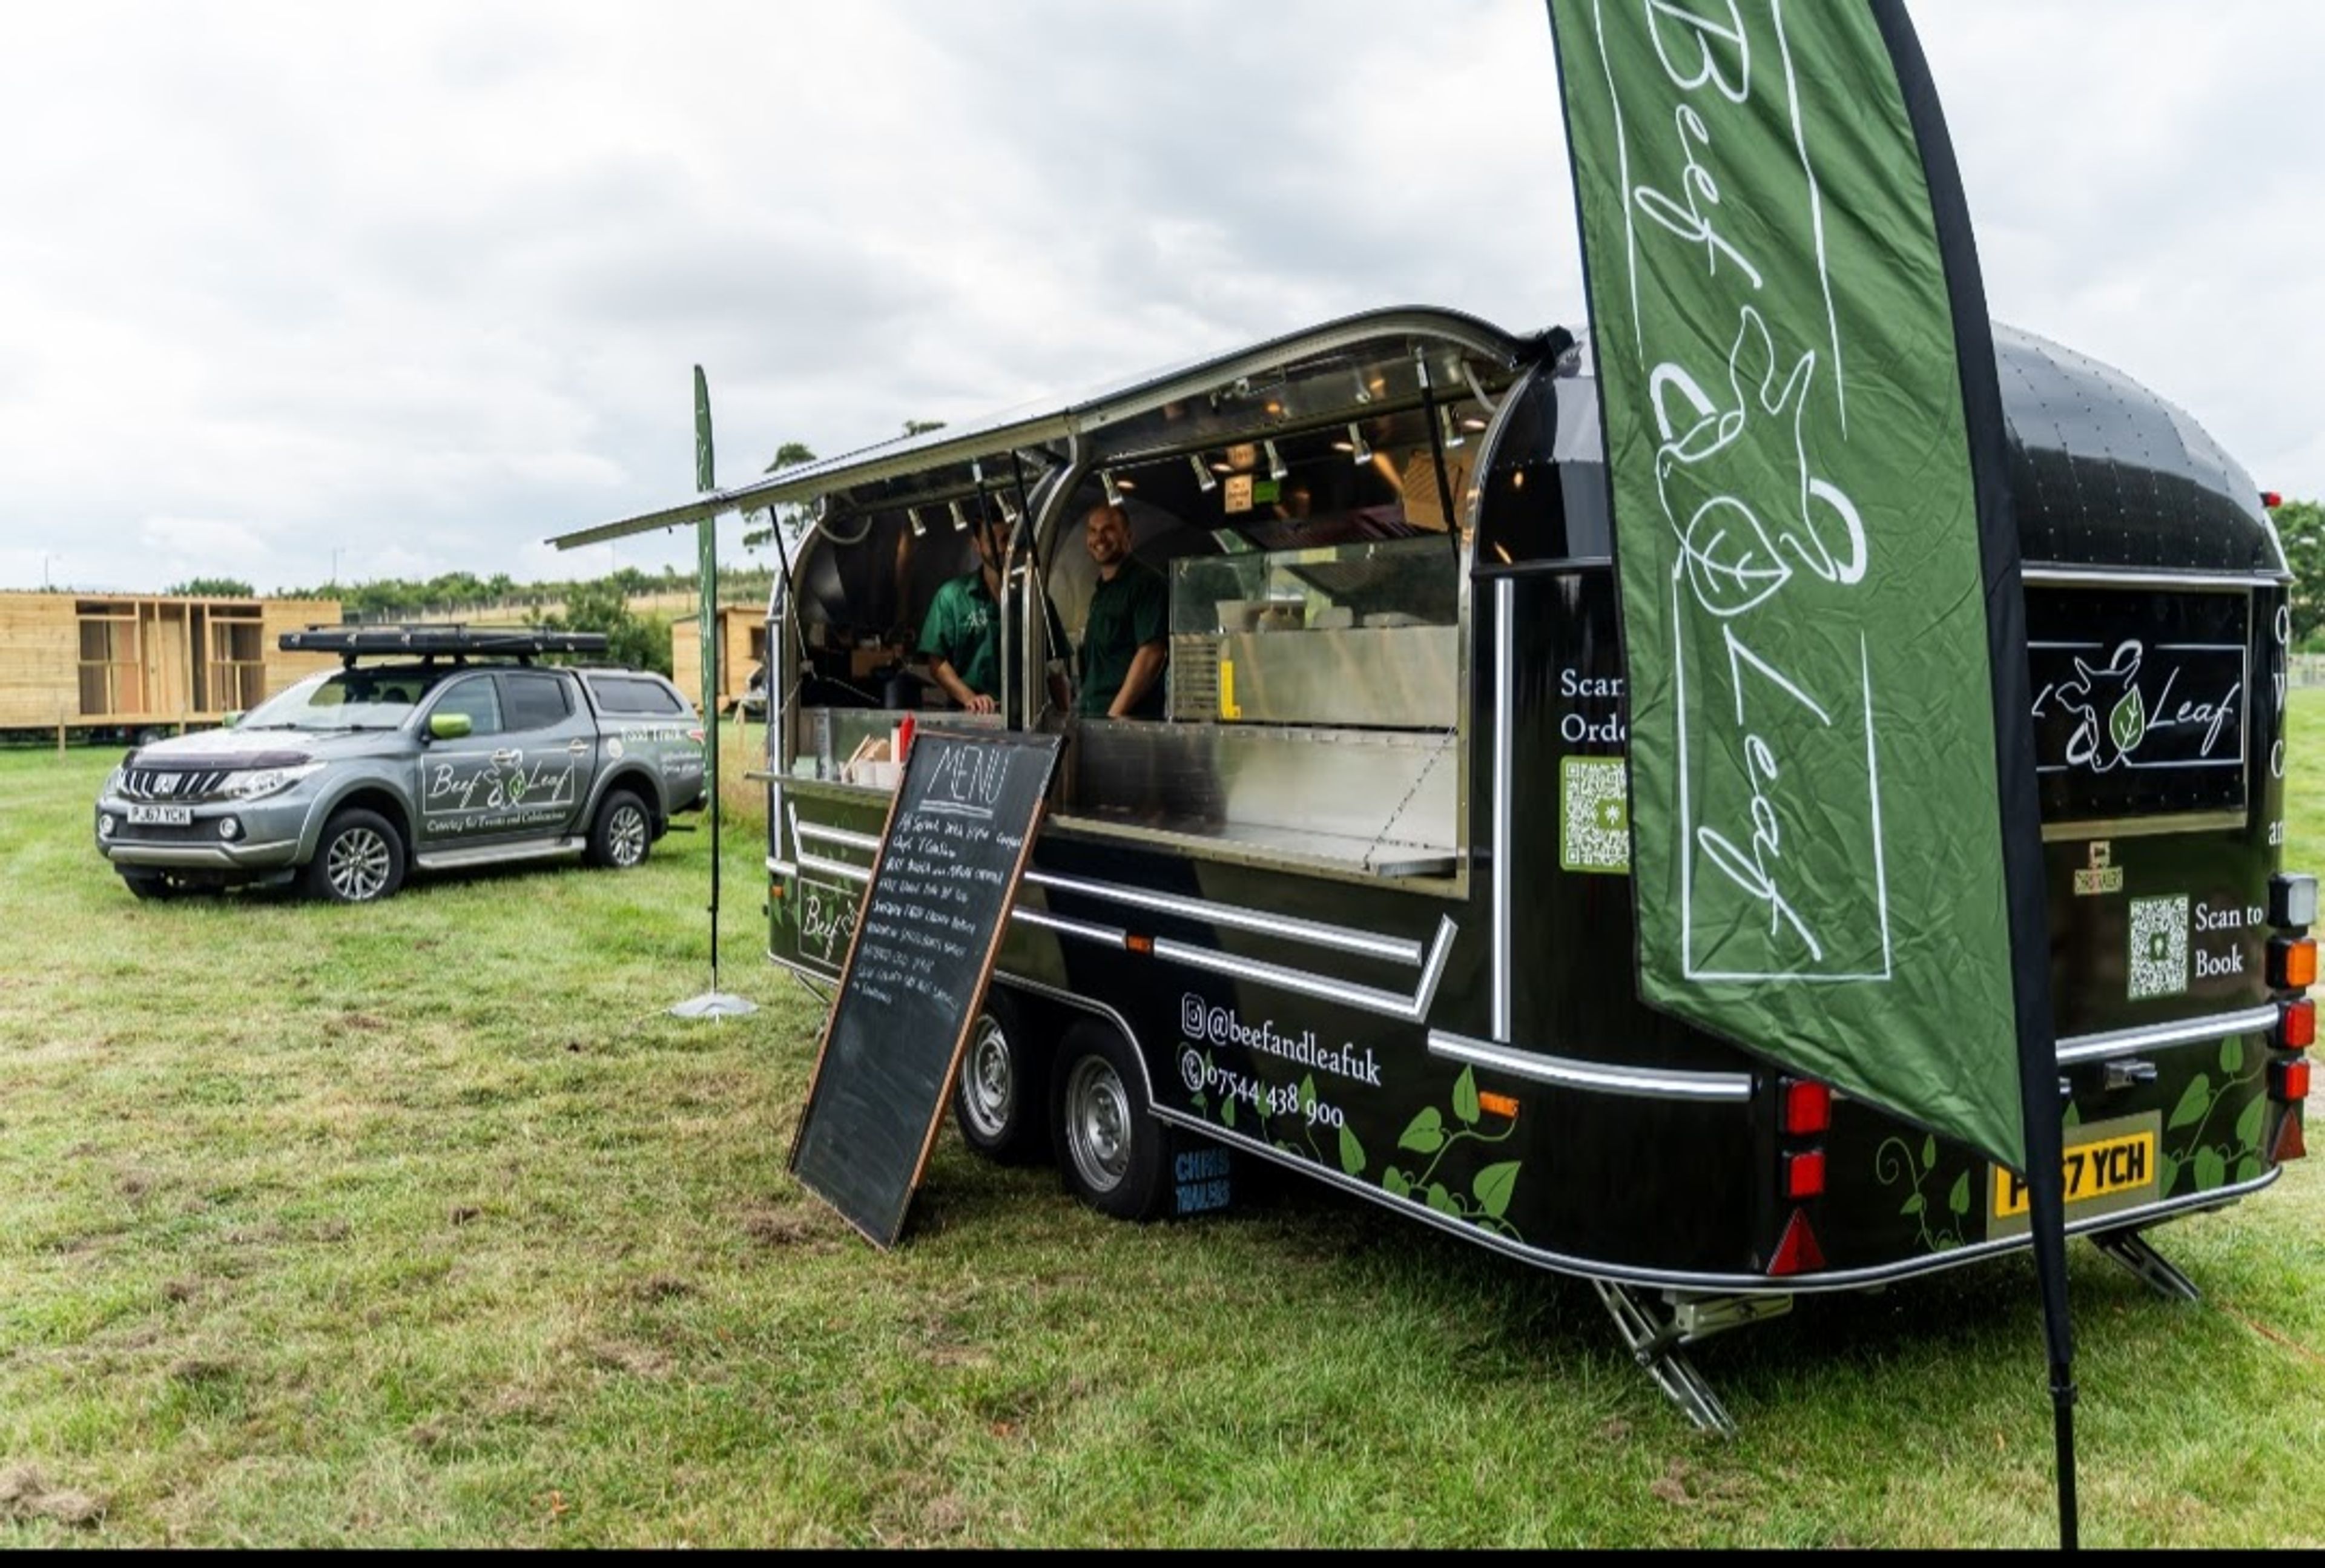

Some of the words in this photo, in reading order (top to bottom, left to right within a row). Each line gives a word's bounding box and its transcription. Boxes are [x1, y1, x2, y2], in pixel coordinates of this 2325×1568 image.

[1634, 0, 1764, 289] Beef
[2146, 666, 2241, 757] Leaf
[427, 763, 483, 809] Beef
[526, 759, 575, 802] Leaf
[927, 745, 1011, 805] MENU
[1697, 623, 1832, 961] Leaf
[132, 806, 161, 821] PJ67
[164, 807, 186, 822] YCH
[802, 895, 842, 961] Beef
[2195, 904, 2241, 932] Scan
[2246, 905, 2263, 925] to
[2195, 946, 2244, 977] Book
[1207, 1006, 1382, 1087] @beefandleafuk
[1206, 1064, 1260, 1107] 07544
[1265, 1082, 1300, 1115] 438
[1305, 1102, 1344, 1130] 900
[2092, 1141, 2145, 1189] YCH
